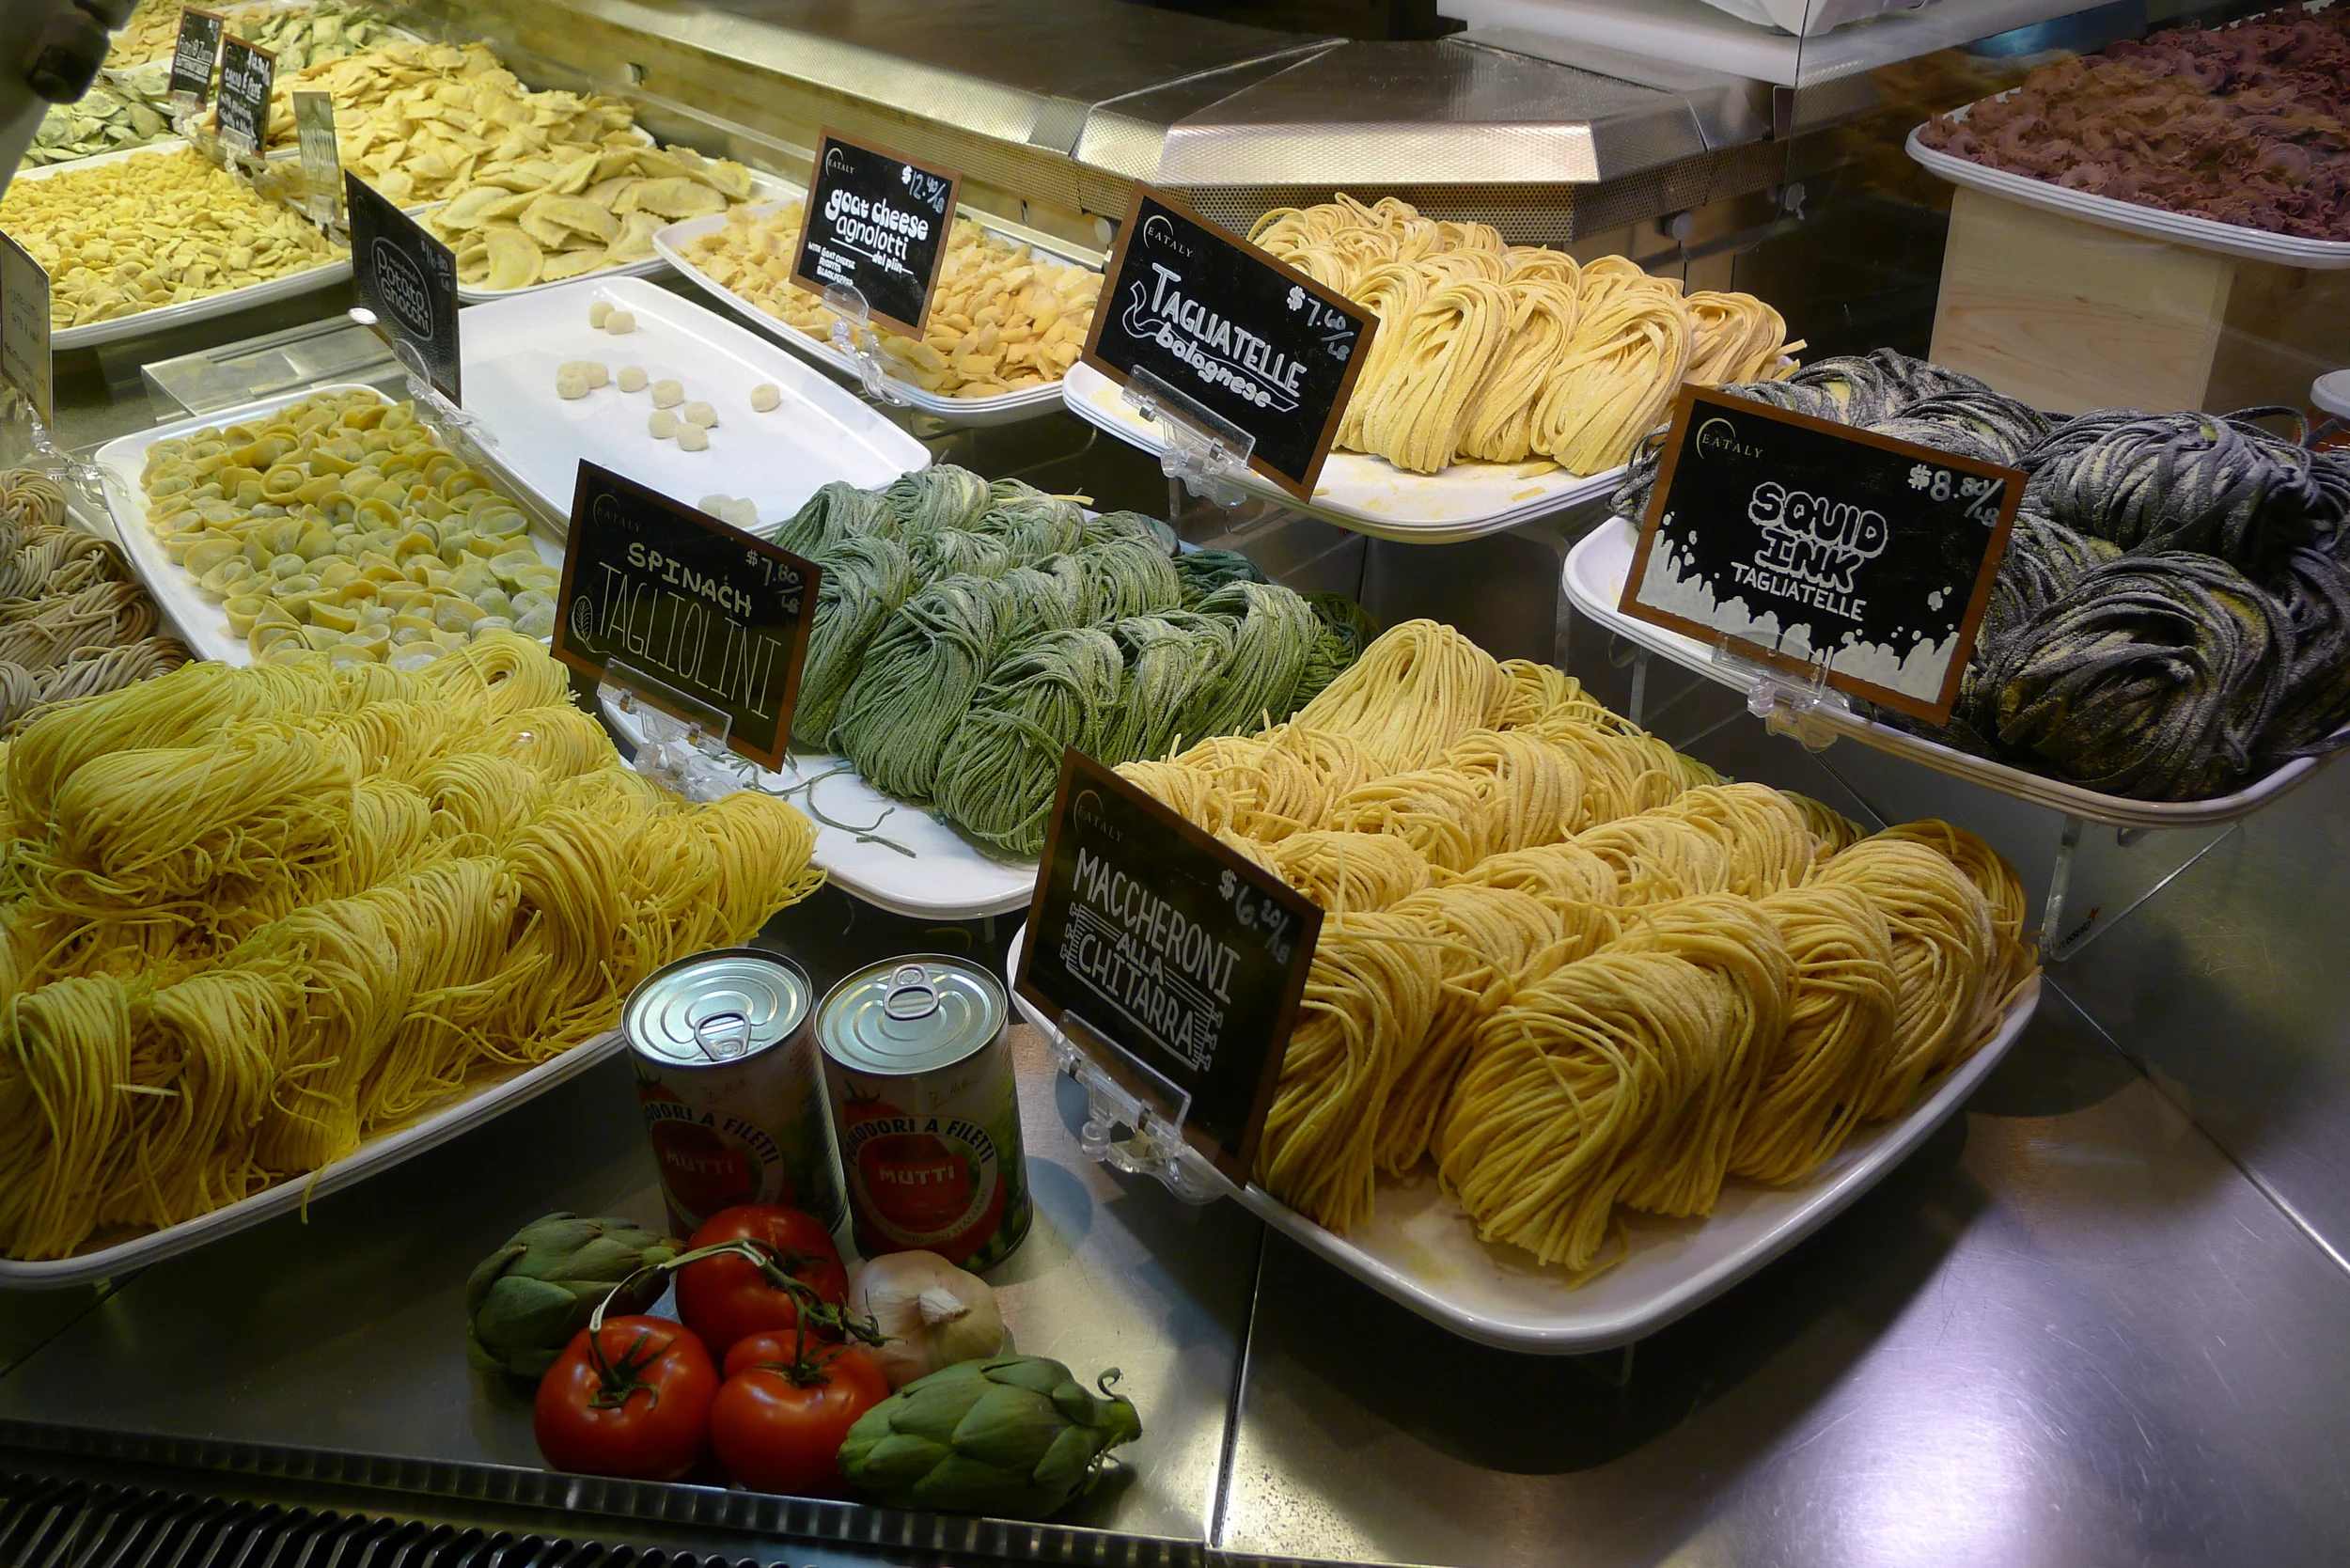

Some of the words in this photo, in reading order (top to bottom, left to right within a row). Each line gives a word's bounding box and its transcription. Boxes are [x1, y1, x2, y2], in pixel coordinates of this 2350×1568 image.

[828, 158, 855, 176] EATALY
[824, 189, 870, 221] goat
[871, 197, 930, 241] cheese
[836, 215, 910, 260] agnolotti
[1148, 227, 1194, 258] EATALY
[377, 246, 424, 310] Potato
[872, 251, 887, 267] del
[381, 277, 430, 333] Gnocchi
[1152, 262, 1307, 398] TAGLIATELLE
[1155, 321, 1272, 408] bolognese
[1701, 433, 1762, 459] EATALY
[597, 507, 641, 533] EATALY
[1748, 481, 1888, 557] SQUID
[627, 542, 752, 618] SPINACH
[1755, 526, 1864, 594] INK
[1731, 561, 1867, 622] TAGLIATELLE
[599, 561, 781, 720] TAGLIOLINI
[1073, 847, 1241, 1005] MACCHERONI
[1116, 933, 1166, 985] ALLA
[1078, 934, 1197, 1057] CHITARRA
[666, 1147, 735, 1175] MUTTI
[698, 1110, 715, 1126] A
[723, 1117, 780, 1165] FILETTI
[923, 1118, 939, 1134] A
[946, 1120, 995, 1165] FILETTI
[879, 1164, 956, 1186] MUTTI
